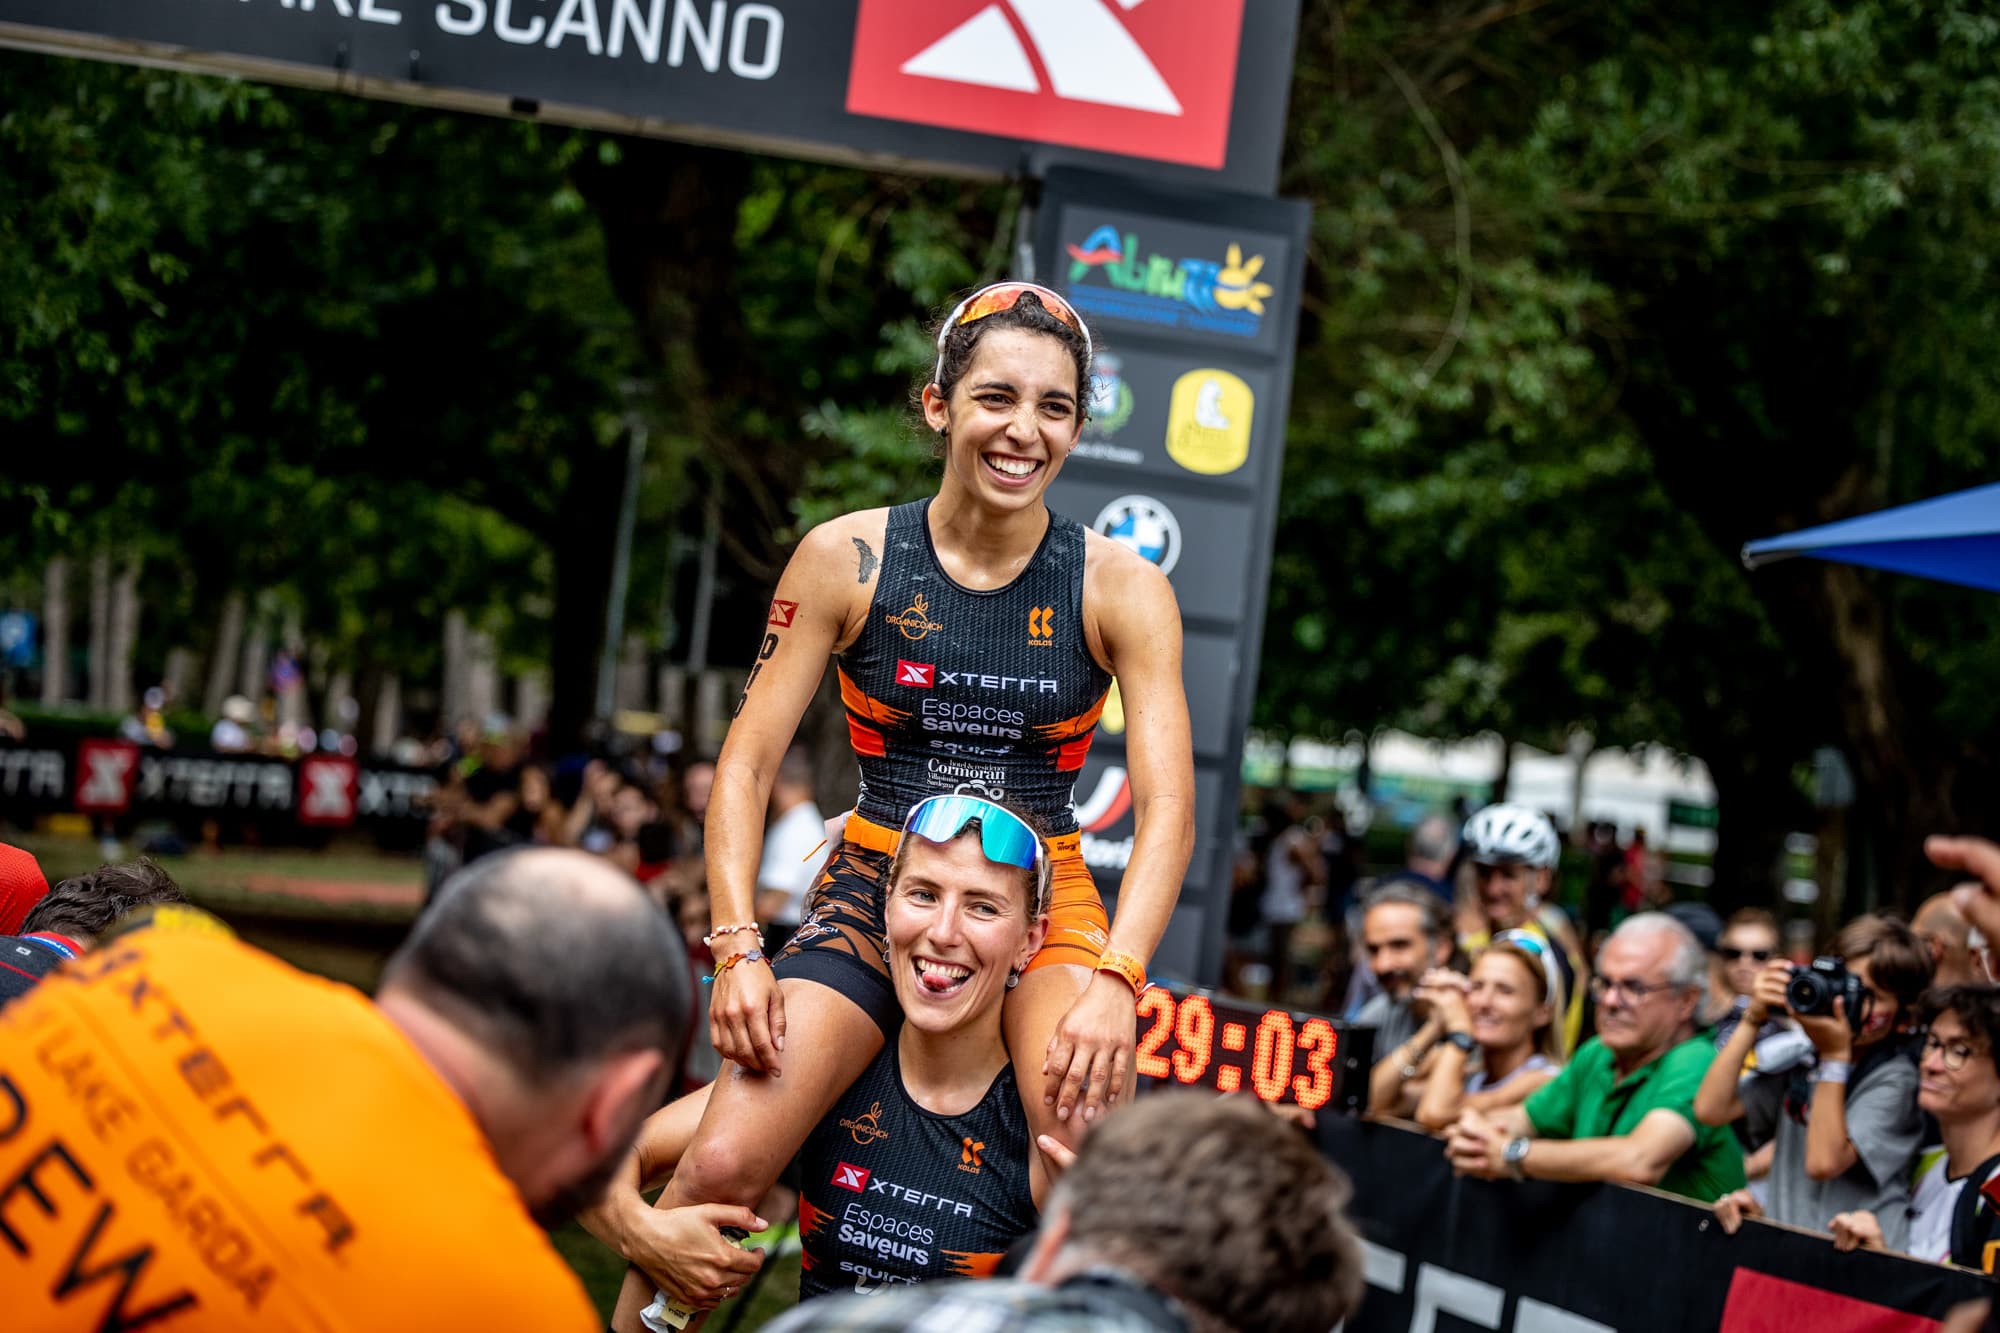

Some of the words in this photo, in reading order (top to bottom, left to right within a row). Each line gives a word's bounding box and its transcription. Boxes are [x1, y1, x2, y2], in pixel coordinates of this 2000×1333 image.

[885, 614, 944, 632] ORGANICOACH
[938, 671, 1058, 693] XTERRA
[922, 698, 1024, 726] Espaces
[922, 717, 1022, 740] Saveurs
[927, 757, 1006, 780] Cormoran
[1135, 986, 1338, 1110] 29:03
[868, 1177, 973, 1218] XTERRA
[843, 1202, 934, 1245] Espaces
[838, 1223, 929, 1266] Saveurs
